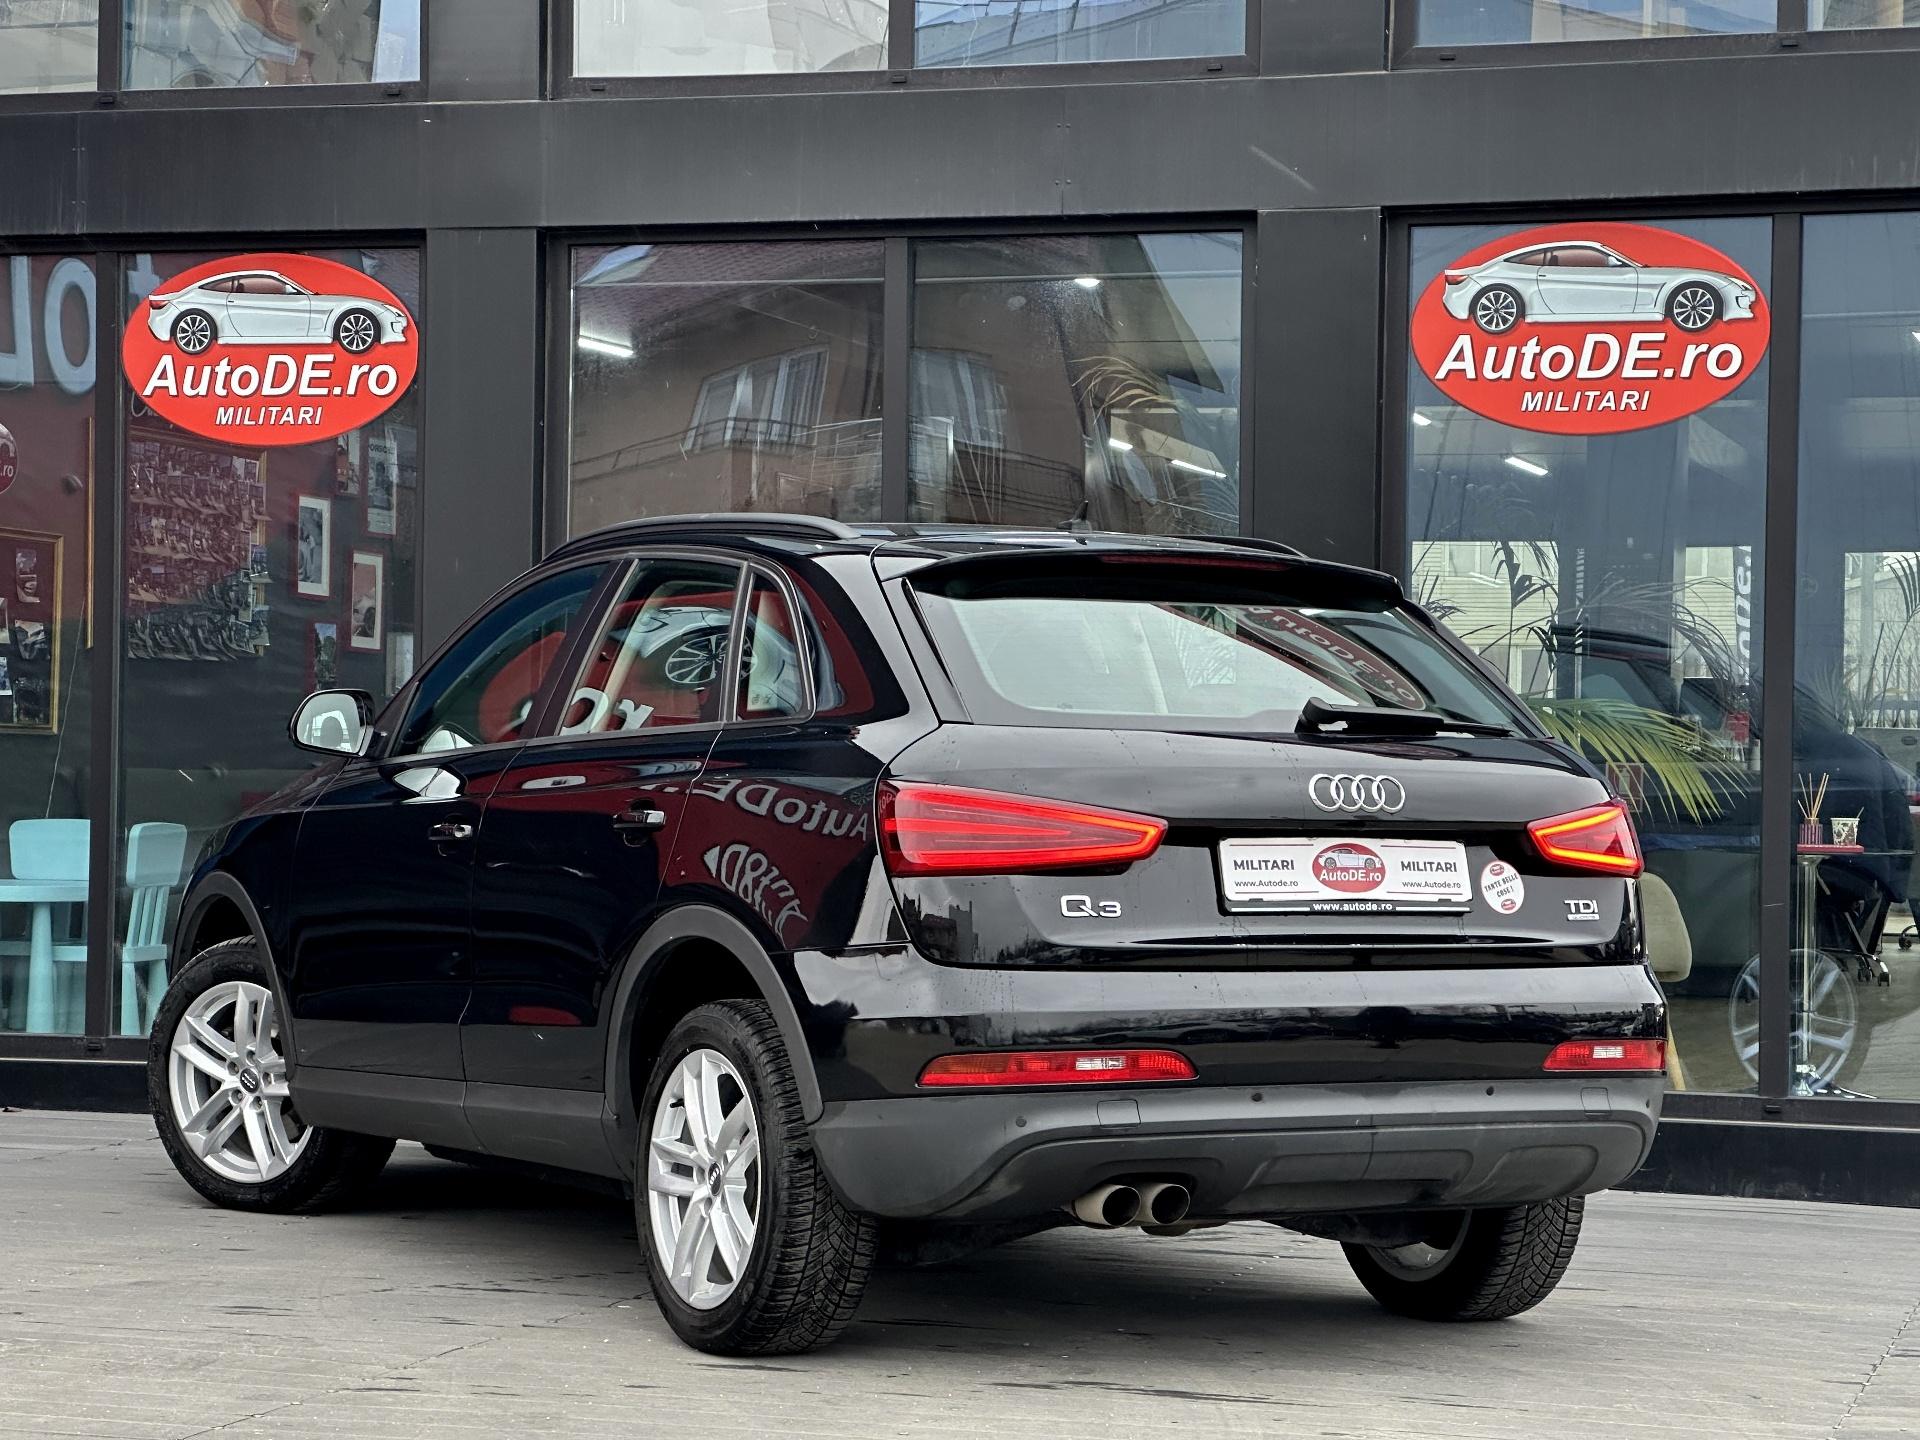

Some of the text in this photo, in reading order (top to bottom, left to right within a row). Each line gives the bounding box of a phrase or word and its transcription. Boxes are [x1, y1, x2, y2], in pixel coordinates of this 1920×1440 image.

[1435, 332, 1743, 380] AutoDE.ro
[143, 353, 399, 397] AutoDE.ro
[1521, 390, 1650, 413] MILITARI
[214, 406, 323, 426] MILITARI
[1233, 860, 1295, 871] MILITARI
[1400, 861, 1458, 873] MILITARI
[1319, 870, 1382, 882] AutoDE.ro
[1235, 880, 1299, 888] www.Autode.ro
[1402, 881, 1461, 889] www.Autode.ro
[1061, 895, 1122, 917] Q3
[1313, 902, 1393, 911] www.autode.ro
[1563, 900, 1599, 914] TDI
